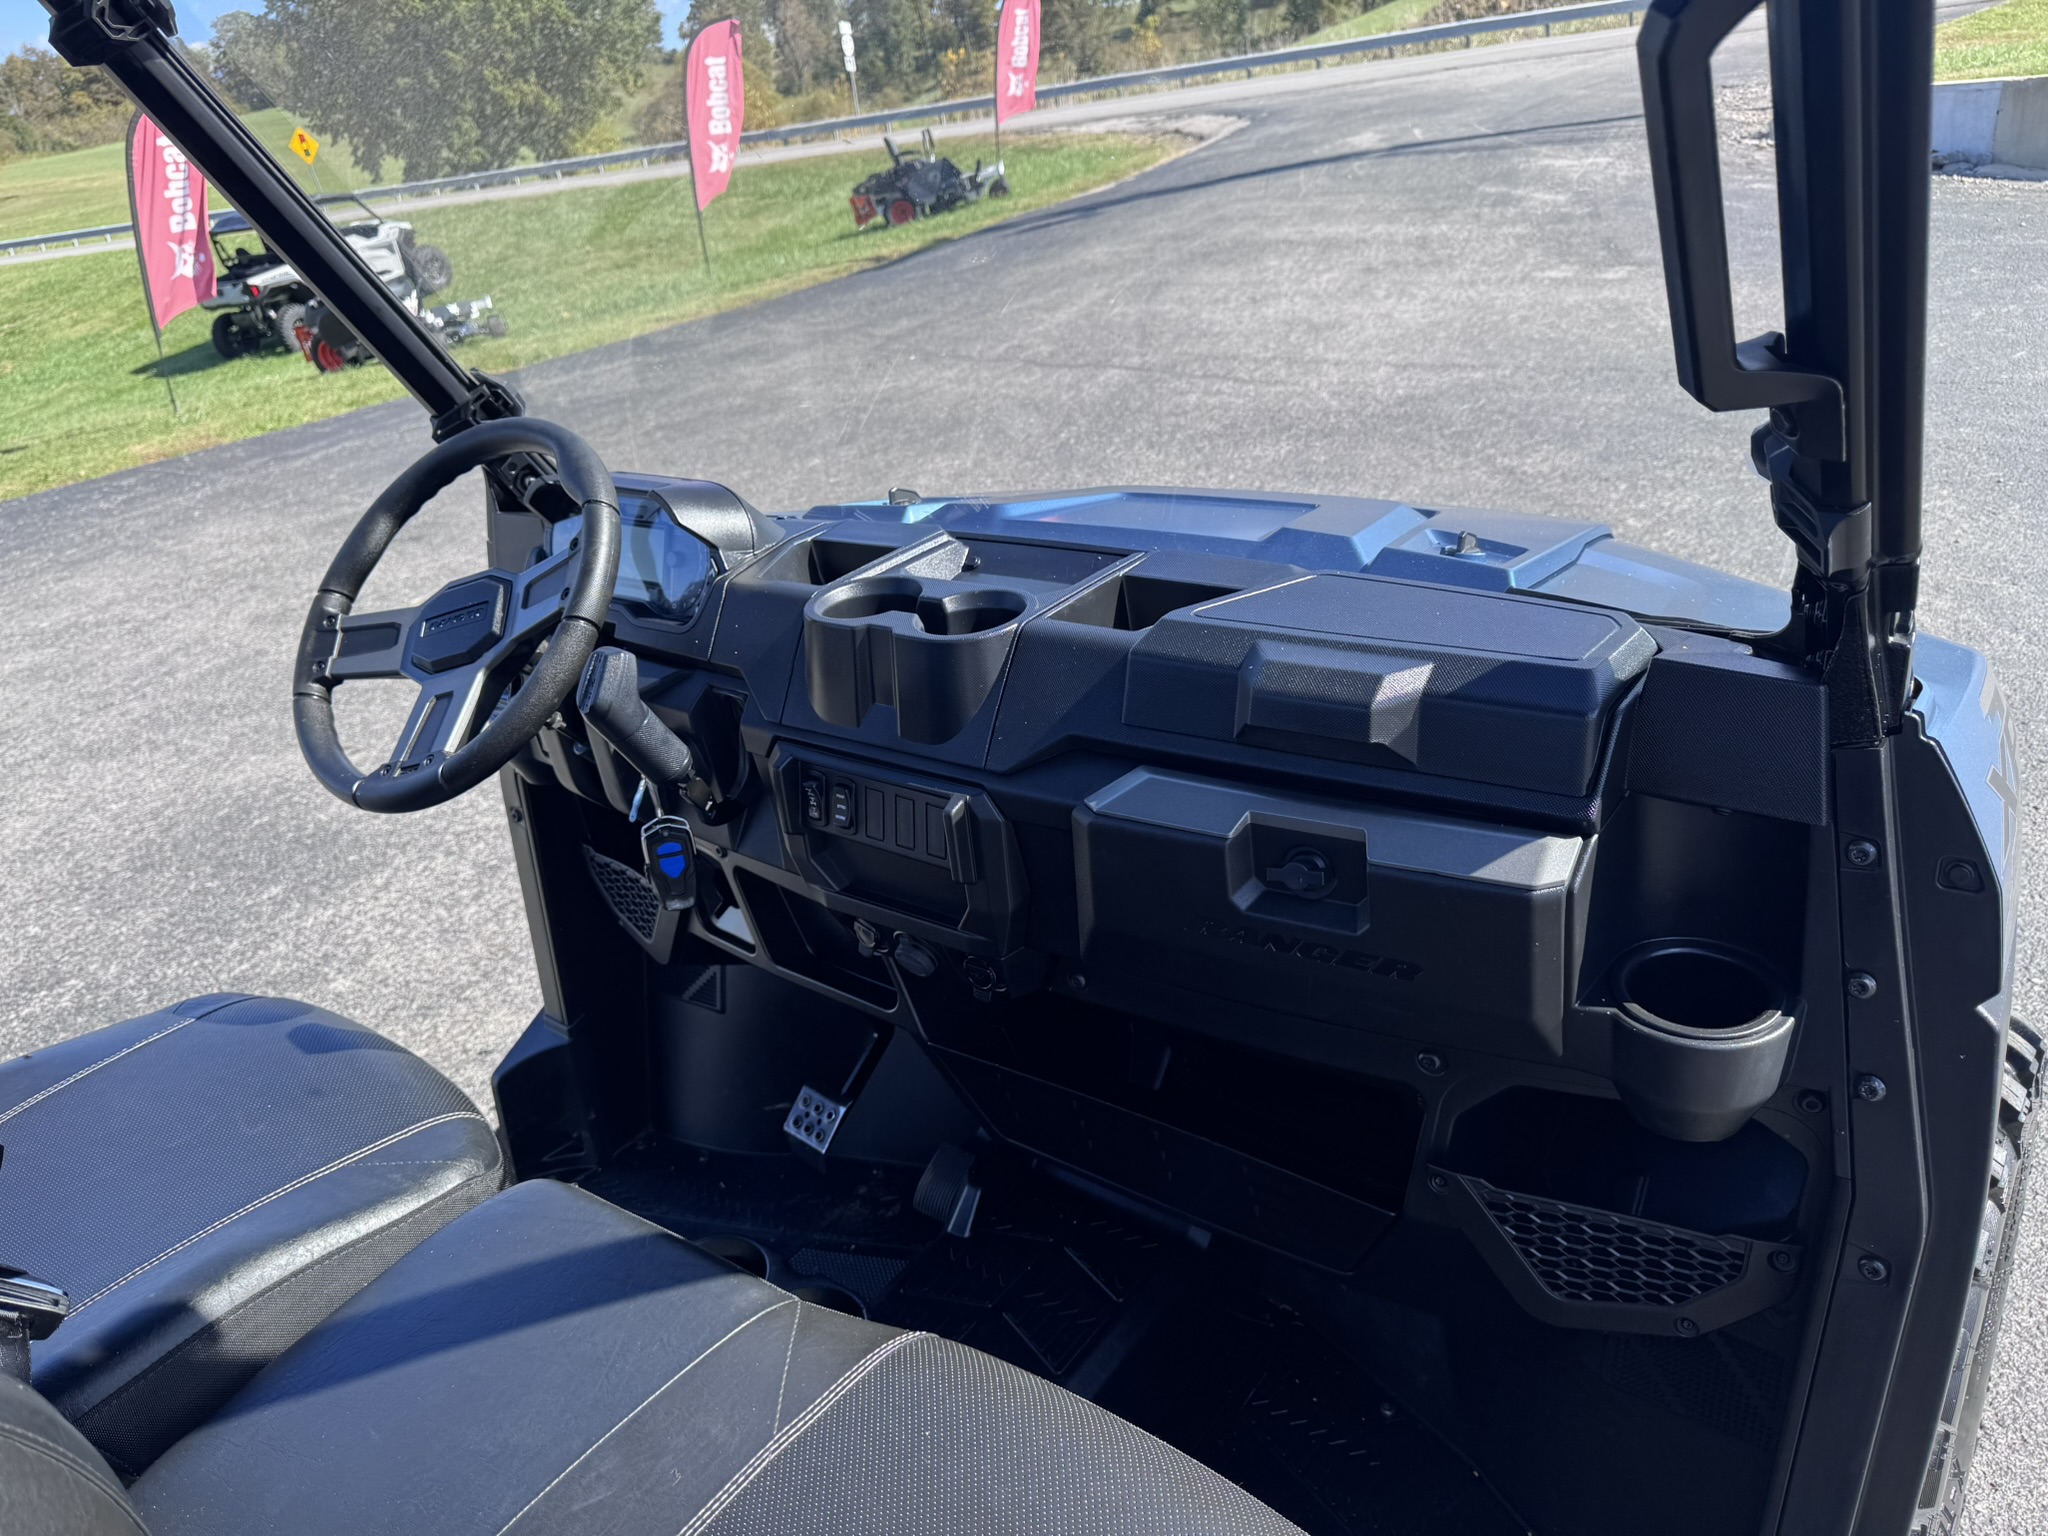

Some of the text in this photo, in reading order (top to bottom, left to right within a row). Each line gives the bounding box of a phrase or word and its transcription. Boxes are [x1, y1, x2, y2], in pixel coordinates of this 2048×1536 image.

[1010, 8, 1029, 68] Bobcat
[704, 56, 732, 135] Bobcat
[1184, 917, 1424, 982] RANGER
